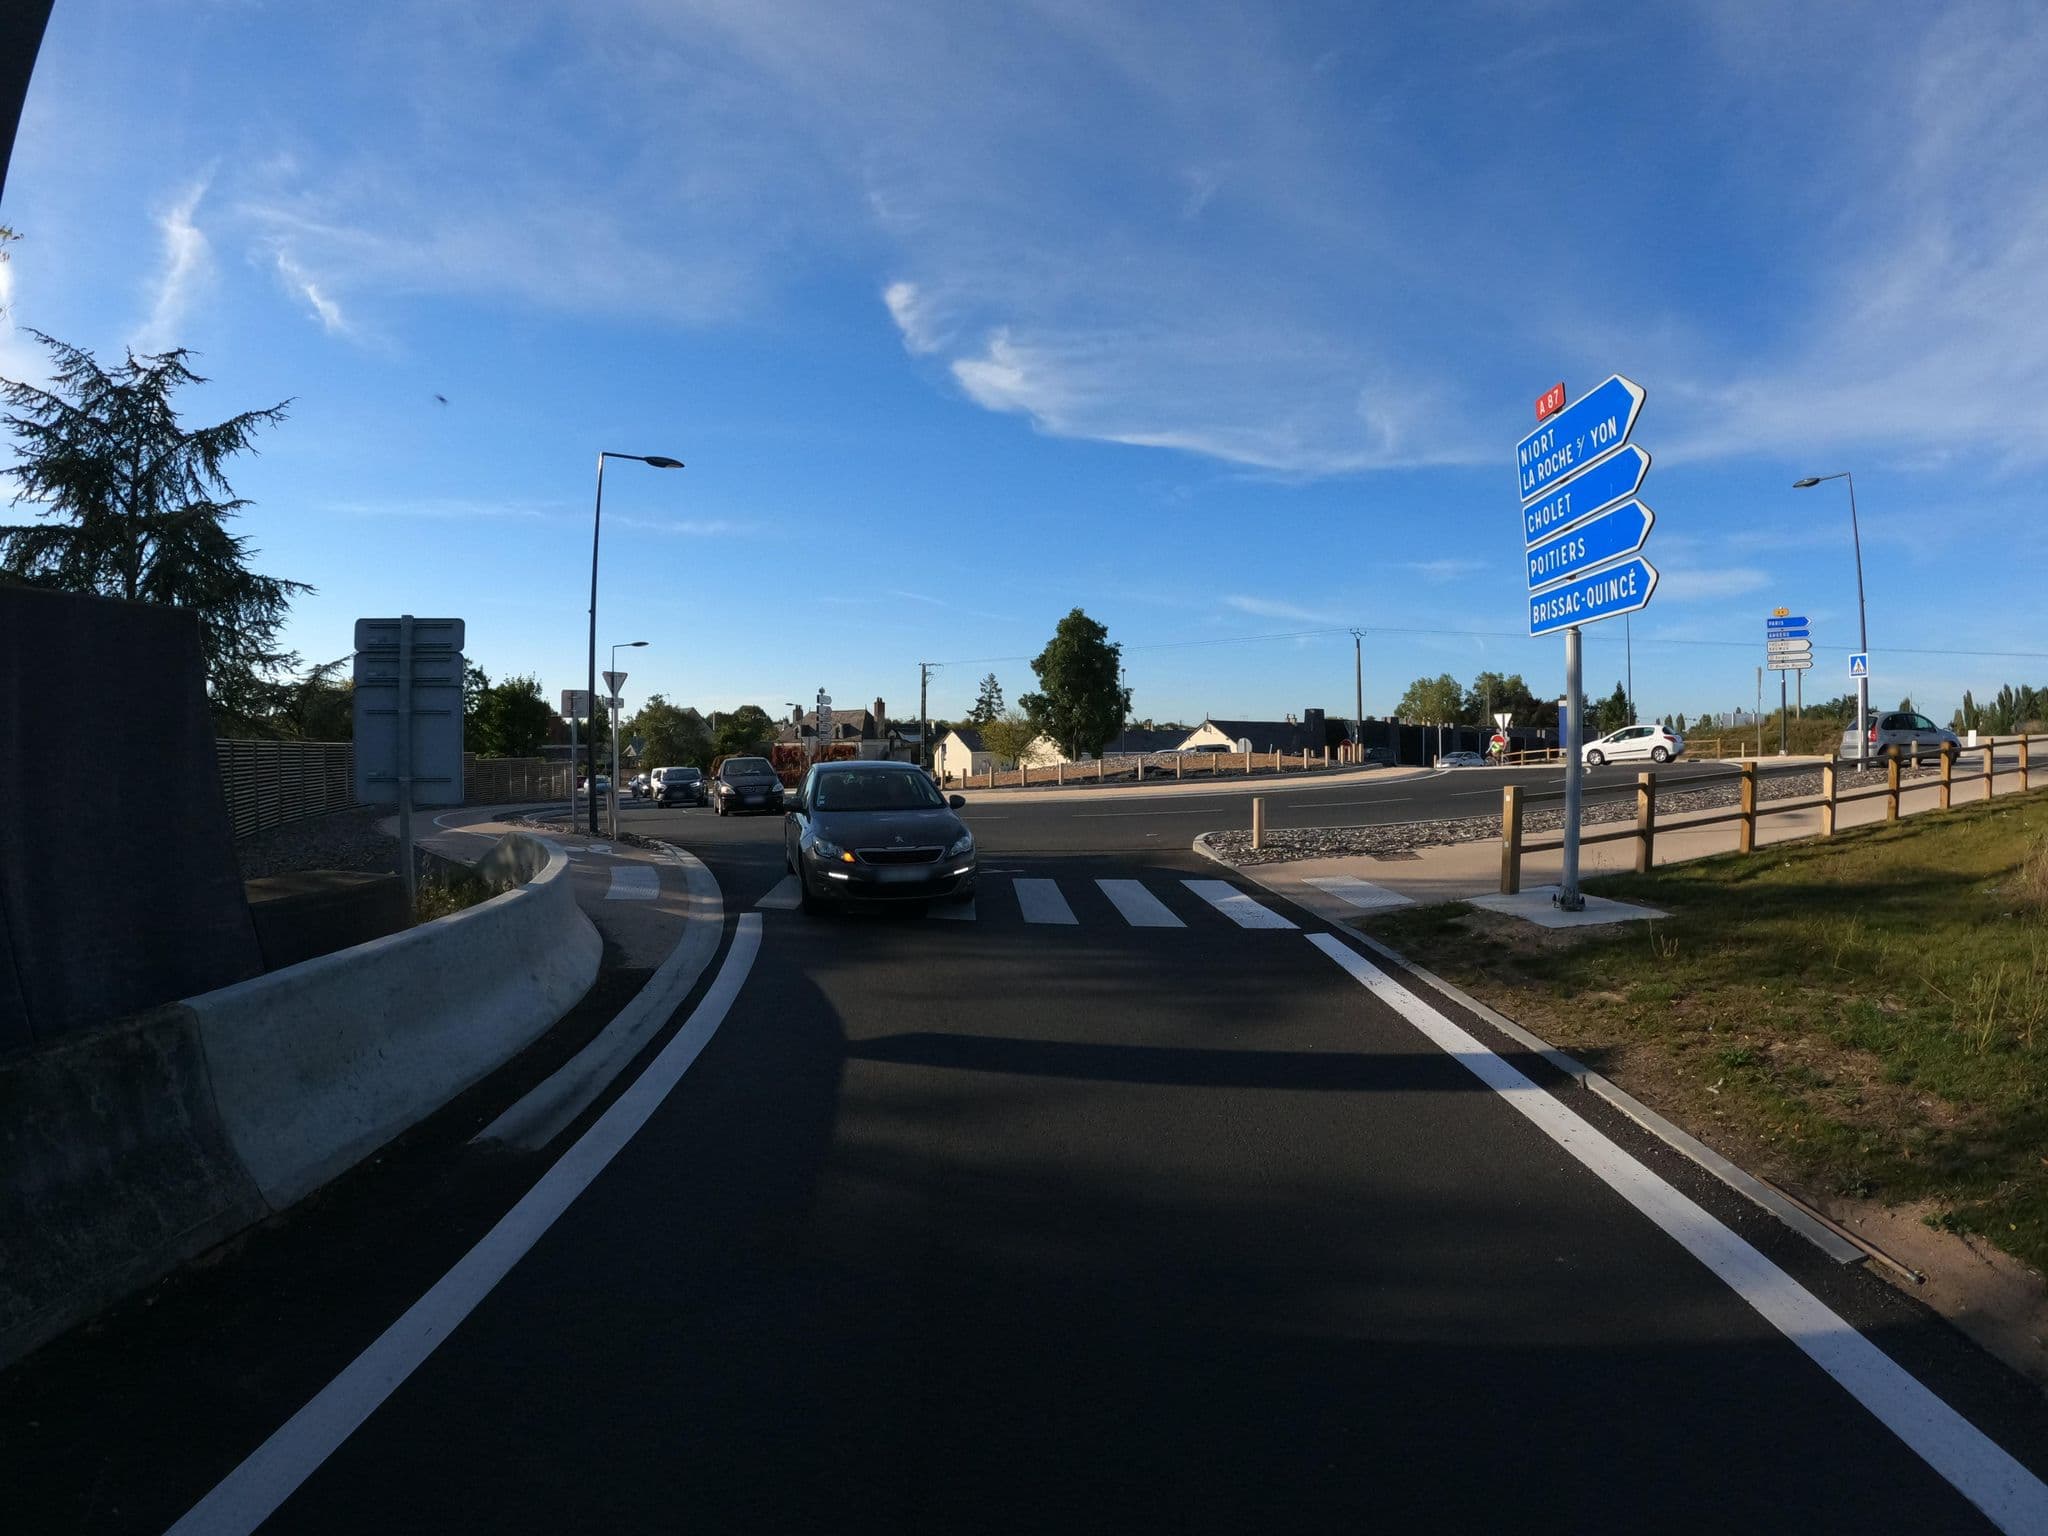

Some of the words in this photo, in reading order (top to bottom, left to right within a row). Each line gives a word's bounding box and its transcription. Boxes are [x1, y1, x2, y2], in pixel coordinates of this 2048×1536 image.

[1540, 398, 1546, 416] A
[1548, 388, 1559, 409] 87
[1520, 428, 1554, 468] NIORT
[1523, 468, 1536, 490] LA
[1538, 444, 1574, 482] ROCHE
[1590, 416, 1617, 448] YON
[1528, 492, 1571, 533] CHOLET
[1530, 537, 1586, 578] POITIERS
[1533, 568, 1637, 624] BRISSAC-QUINCÉ
